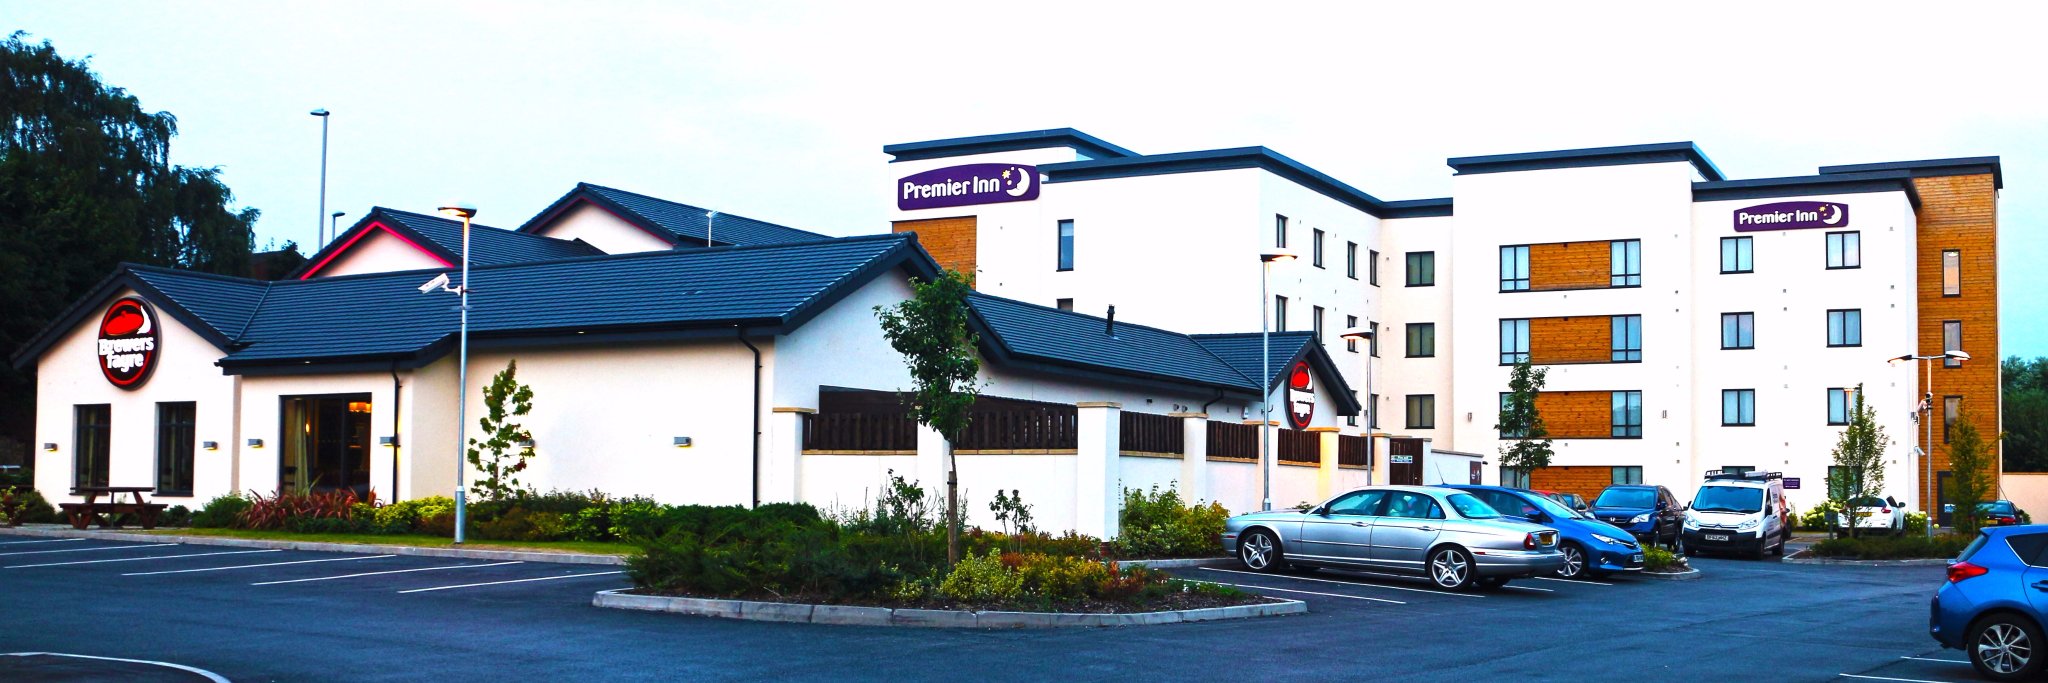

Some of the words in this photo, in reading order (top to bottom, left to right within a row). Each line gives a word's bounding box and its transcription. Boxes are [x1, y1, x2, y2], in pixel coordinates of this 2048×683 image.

[903, 178, 971, 200] Premier
[973, 175, 1000, 194] Inn
[1739, 210, 1795, 225] Premier
[1796, 209, 1818, 222] Inn
[98, 336, 155, 356] Brewers
